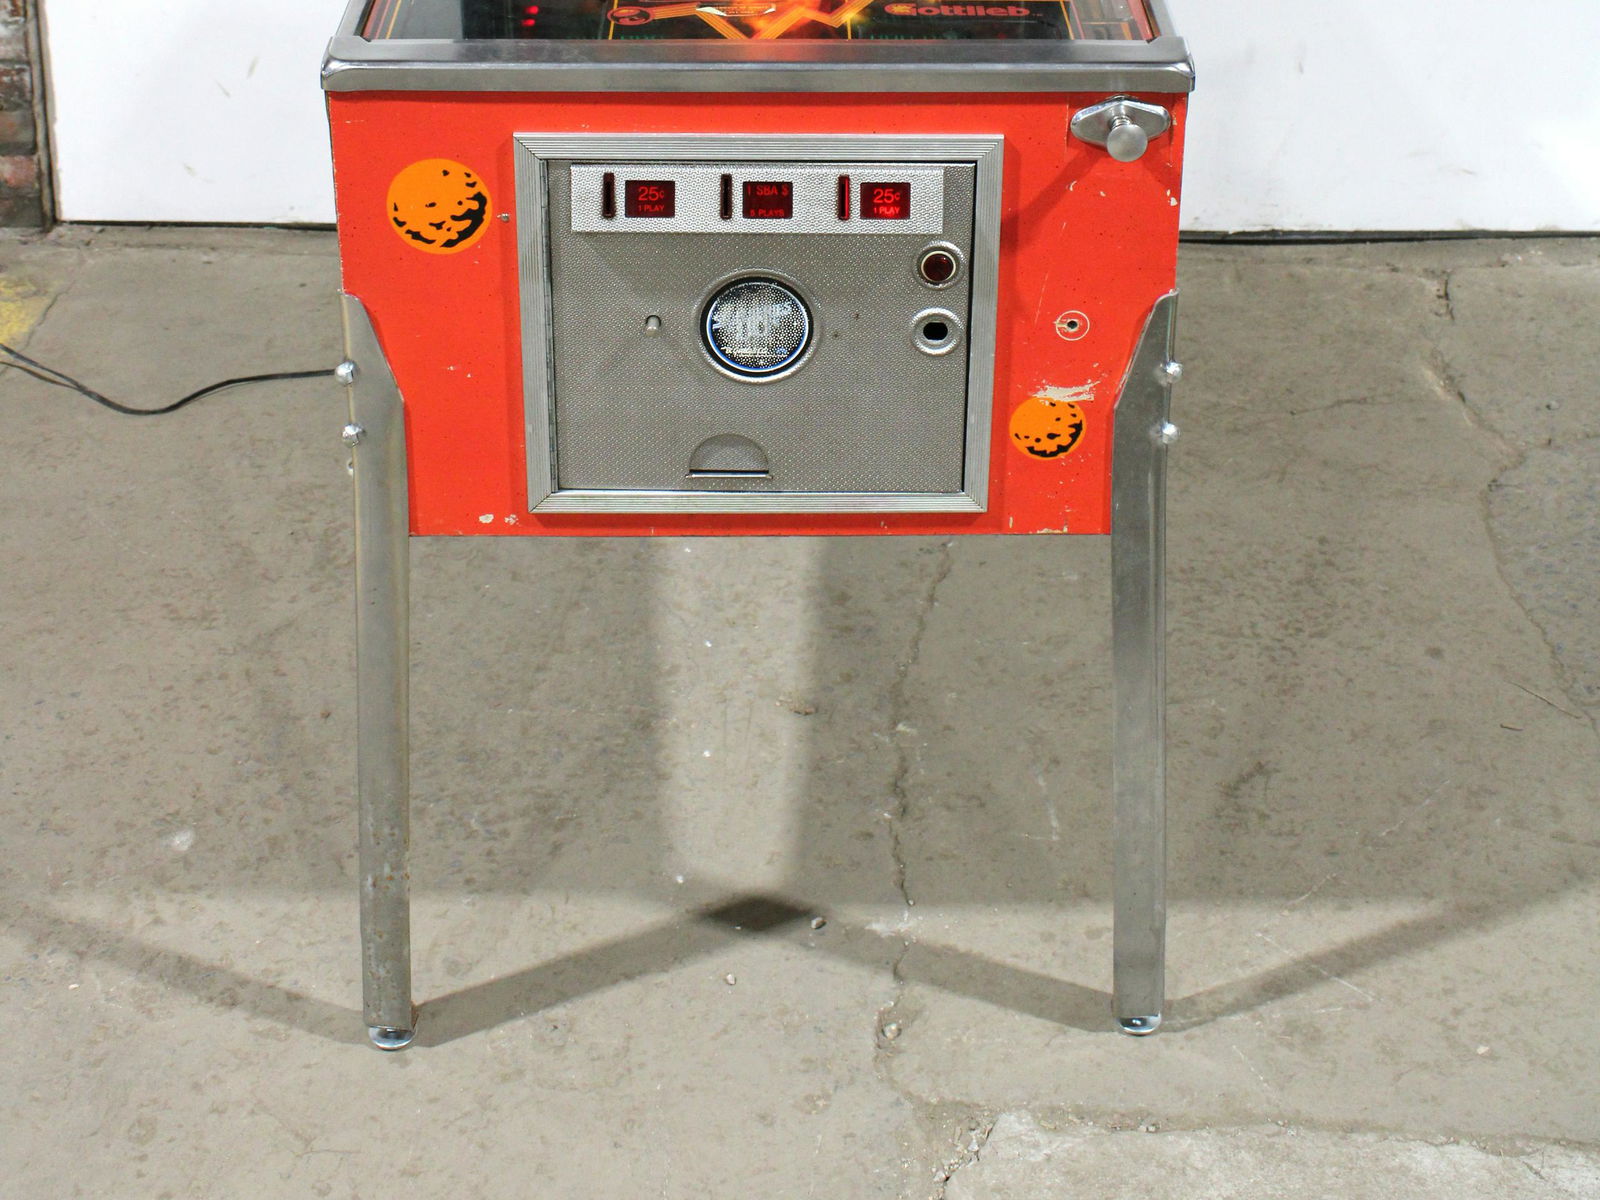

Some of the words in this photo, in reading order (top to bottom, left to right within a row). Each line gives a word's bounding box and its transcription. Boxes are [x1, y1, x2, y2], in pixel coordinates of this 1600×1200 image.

[884, 3, 1031, 17] Gottlieb
[756, 184, 778, 196] SBA
[643, 204, 665, 212] PLAY
[879, 206, 901, 214] PLAY
